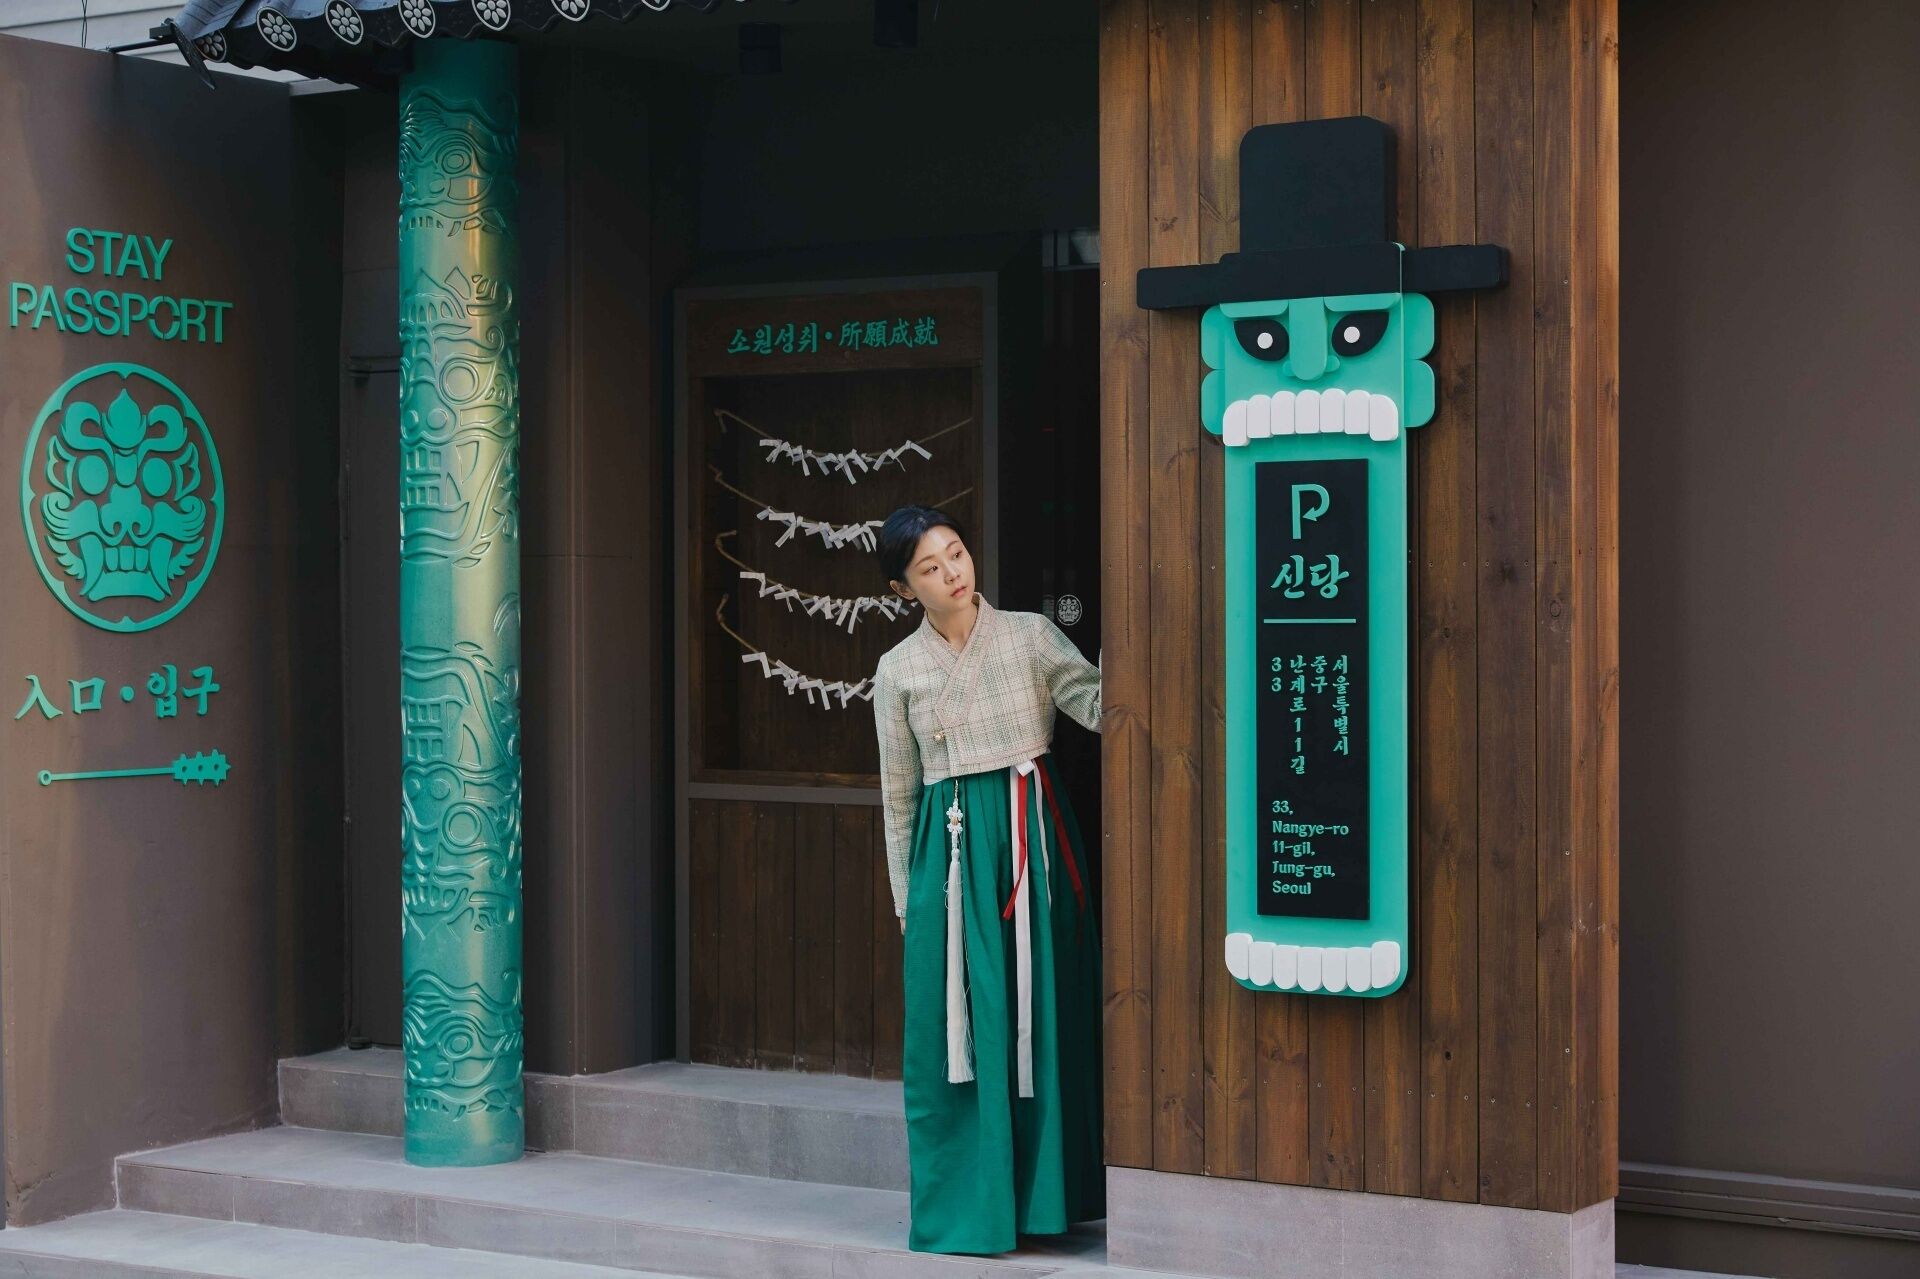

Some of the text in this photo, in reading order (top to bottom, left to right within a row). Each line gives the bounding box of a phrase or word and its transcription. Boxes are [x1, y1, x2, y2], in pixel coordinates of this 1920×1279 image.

[65, 226, 173, 281] STAY
[9, 281, 234, 344] PASSPORT
[1270, 554, 1350, 599] 신당
[1271, 656, 1282, 693] 33
[1310, 655, 1328, 694] 중구
[1332, 654, 1350, 756] 서울특별시
[1272, 800, 1294, 815] 33,
[1272, 820, 1350, 838] Nangye-ro
[1272, 840, 1316, 858] 11-gil,
[1272, 860, 1336, 878] Jung-gu,
[1272, 880, 1312, 895] Seoul
